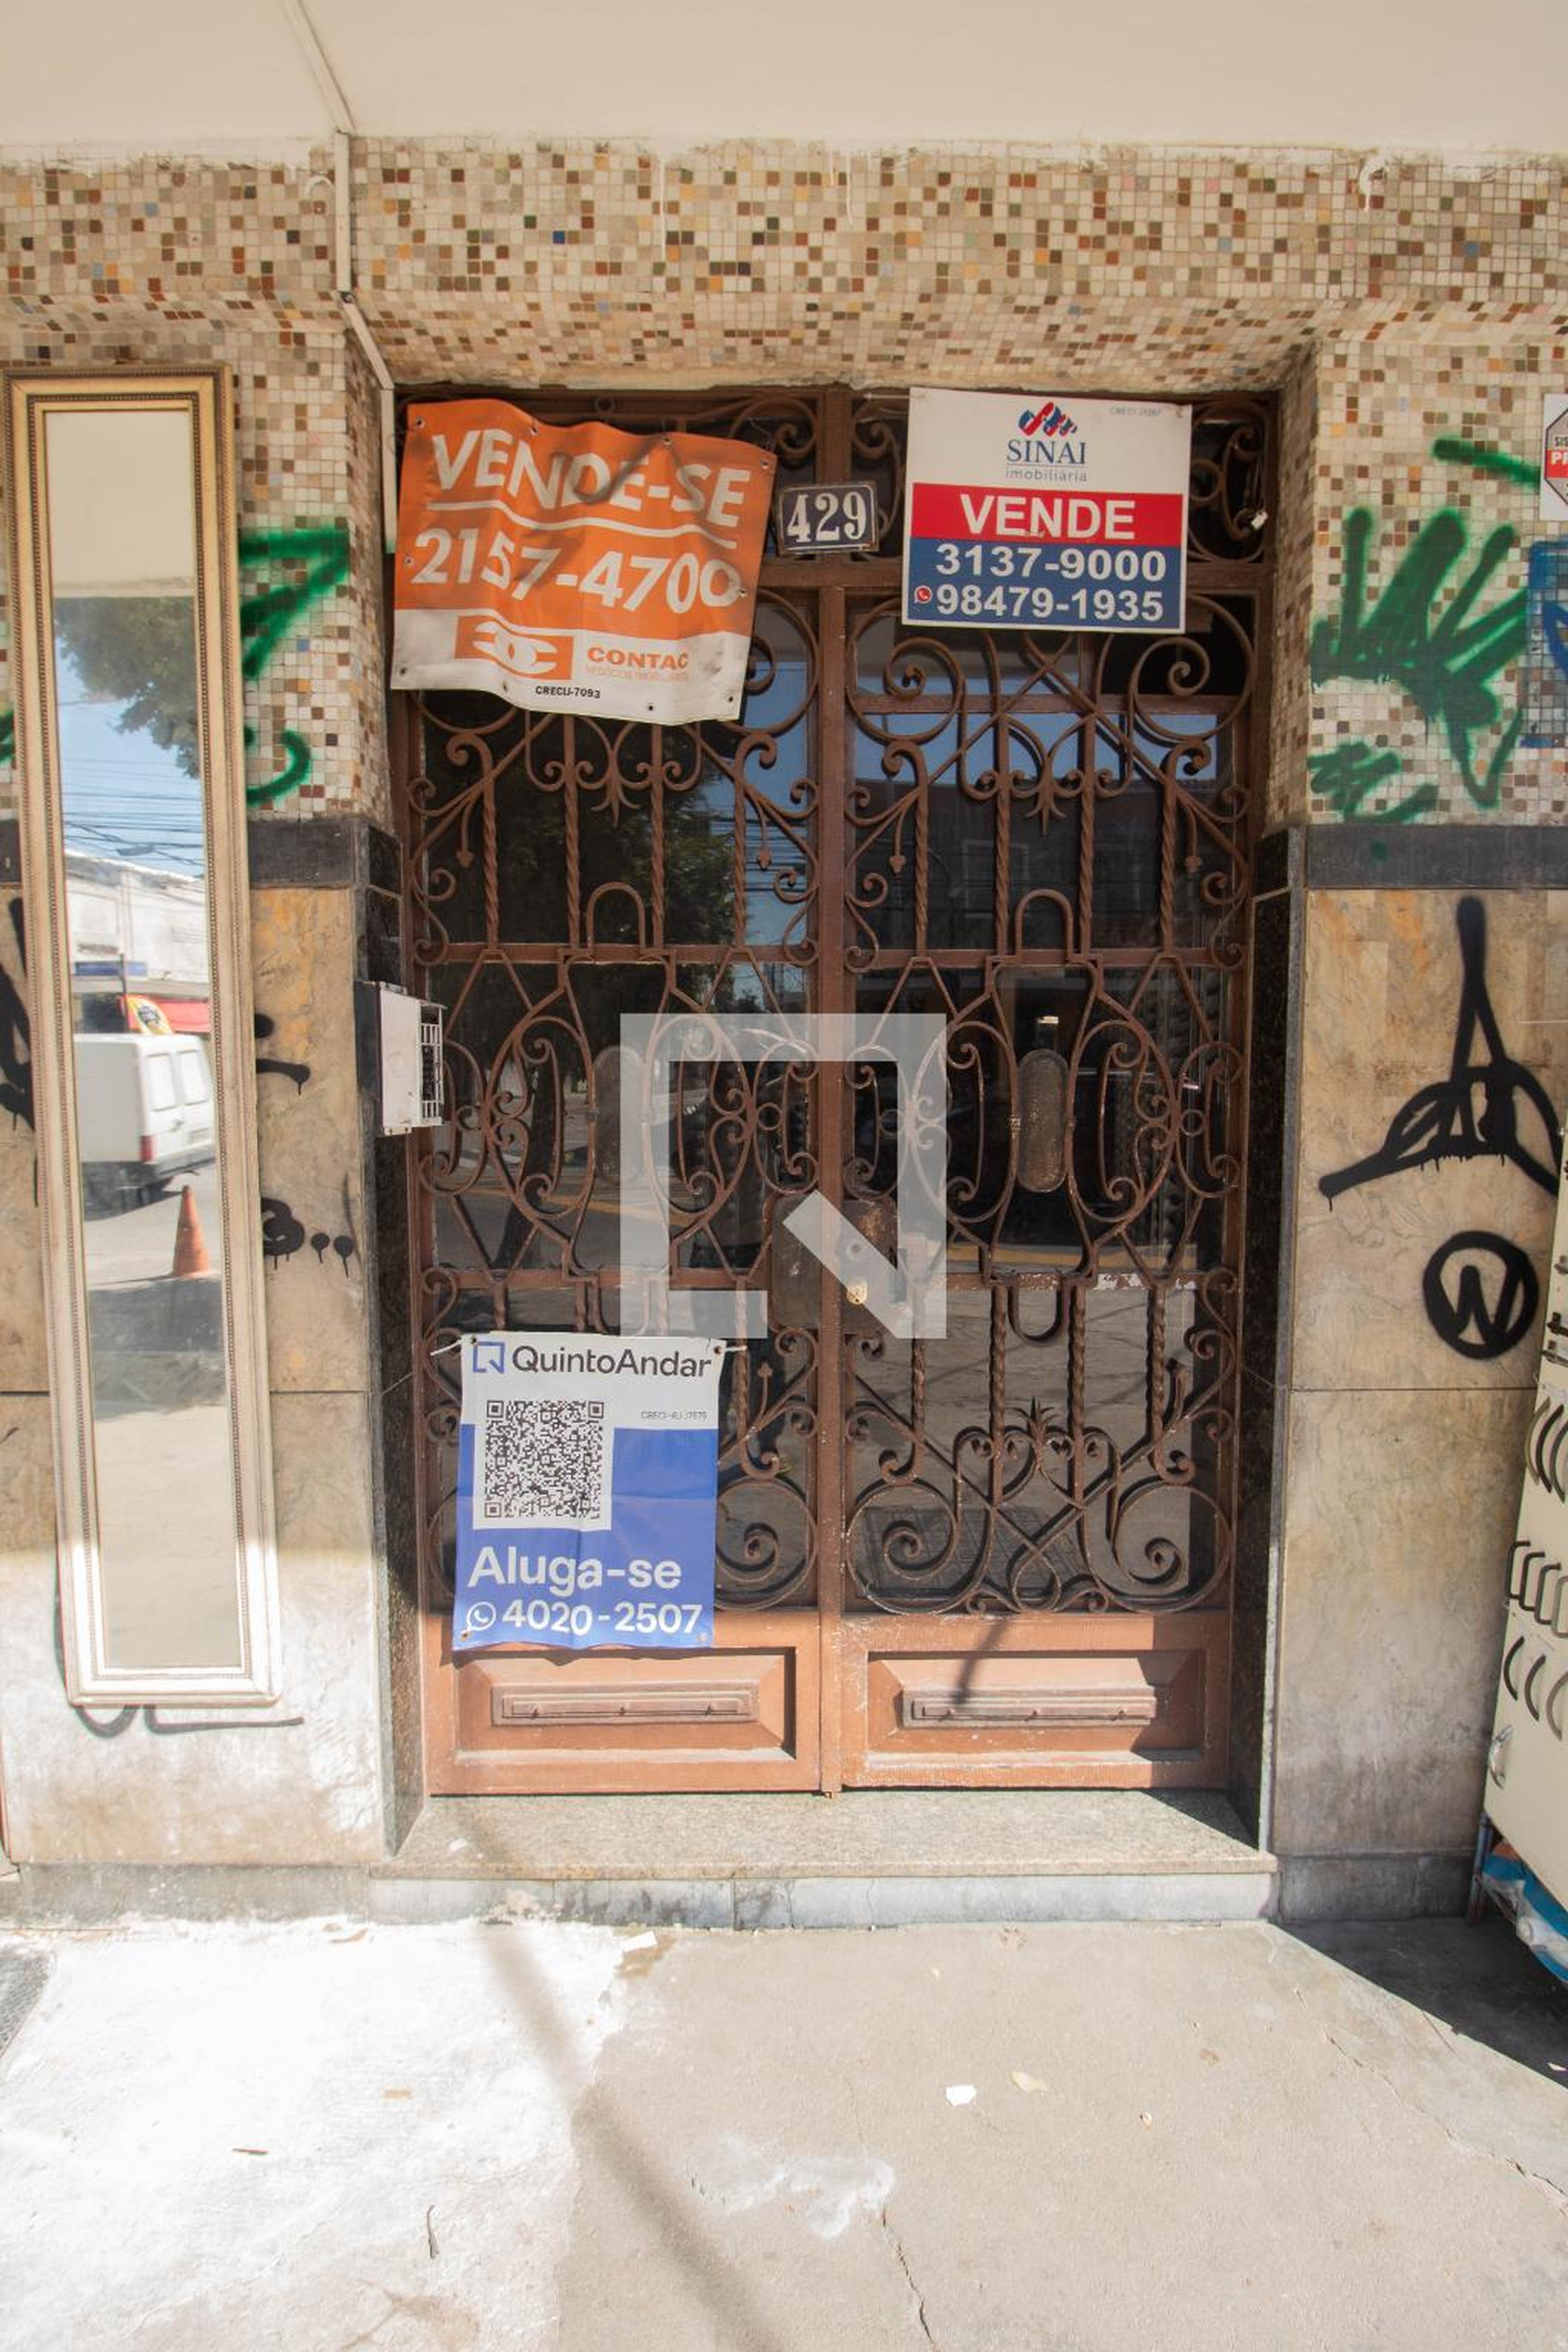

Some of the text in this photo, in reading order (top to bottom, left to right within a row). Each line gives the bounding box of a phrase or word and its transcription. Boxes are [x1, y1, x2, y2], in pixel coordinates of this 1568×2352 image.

[1006, 439, 1086, 465] SINAI
[432, 429, 750, 528] VENDE-SE
[786, 491, 866, 543] 429
[960, 493, 1136, 540] VENDE
[410, 528, 742, 614] 2157-4700
[935, 543, 1167, 581] 3137-9000
[936, 584, 1164, 621] 98479-1935
[512, 1344, 712, 1377] QuintoAndar
[467, 1546, 682, 1597] Aluga-se
[501, 1599, 703, 1636] 4020-2507
